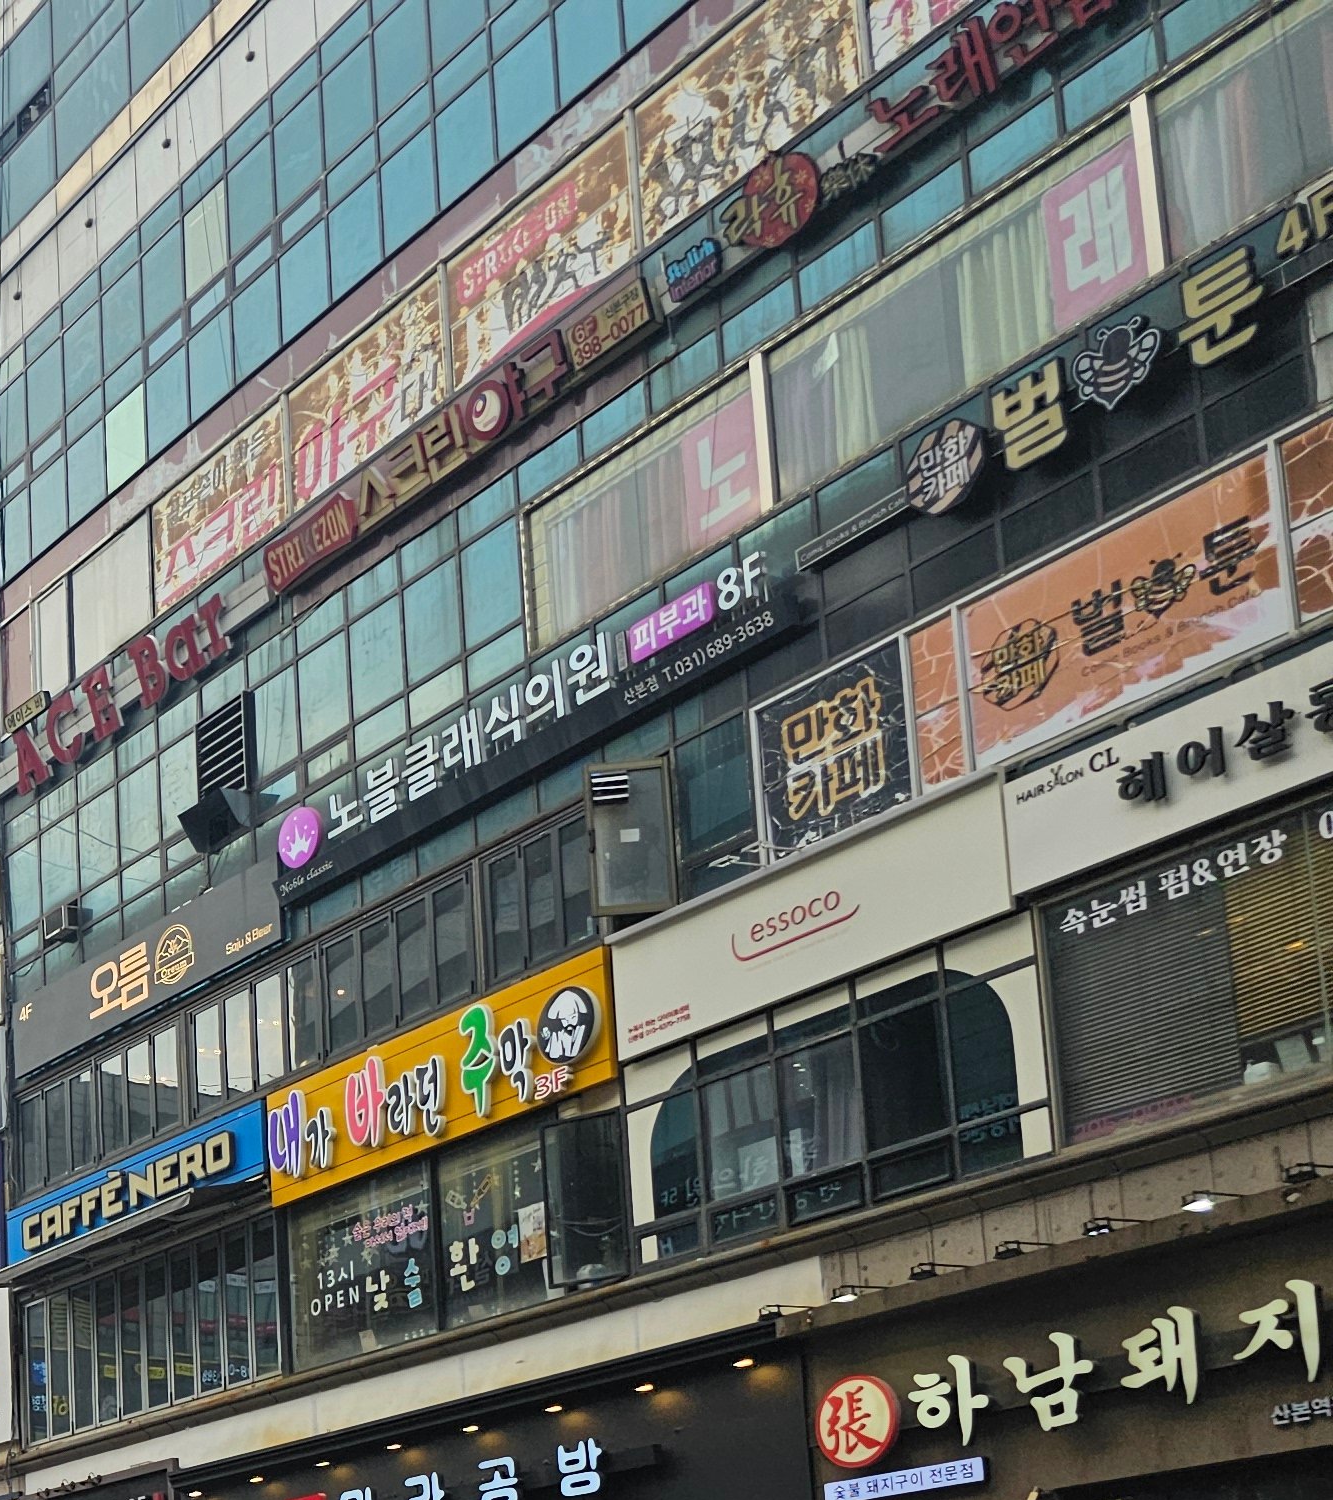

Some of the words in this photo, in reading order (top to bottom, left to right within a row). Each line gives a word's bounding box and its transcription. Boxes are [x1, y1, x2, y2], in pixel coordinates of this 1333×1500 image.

[1058, 163, 1136, 293] 래
[570, 312, 598, 347] 6F
[573, 301, 647, 370] 398-0077
[357, 328, 569, 534] 스크린야구
[917, 430, 968, 477] 만화
[696, 435, 753, 535] 노
[923, 460, 972, 503] 카페
[267, 501, 354, 587] STRIKEZON
[632, 589, 709, 652] 피부과
[715, 550, 763, 612] 8F
[11, 667, 126, 797] ACE
[127, 592, 231, 709] Bar
[622, 674, 660, 706] 산본점
[662, 609, 775, 683] T.031)689-3638
[325, 630, 614, 844] 노블클래식의원
[780, 675, 884, 765] 만화
[786, 731, 886, 822] 카페
[1015, 781, 1046, 805] HAIR
[1088, 745, 1122, 772] CL
[278, 874, 307, 897] Noble
[748, 888, 843, 943] essoco
[1058, 880, 1151, 936] 속눈썹
[1157, 827, 1288, 900] 펌&연장
[254, 921, 275, 944] Beer
[18, 1001, 34, 1025] 4F
[89, 938, 152, 1022] 오름
[267, 1088, 336, 1180] 내가
[344, 1053, 449, 1149] 바라던
[458, 1001, 534, 1120] 주막
[533, 1065, 571, 1103] 3F
[21, 1168, 129, 1254] CAFFÈ
[126, 1130, 234, 1209] NERO
[309, 1284, 362, 1318] OPEN
[317, 1263, 357, 1293] 13시
[907, 1277, 1323, 1448] 하남돼지
[832, 1480, 862, 1500] 숯불
[864, 1469, 926, 1496] 돼지구이
[926, 1459, 976, 1485] 전문점
